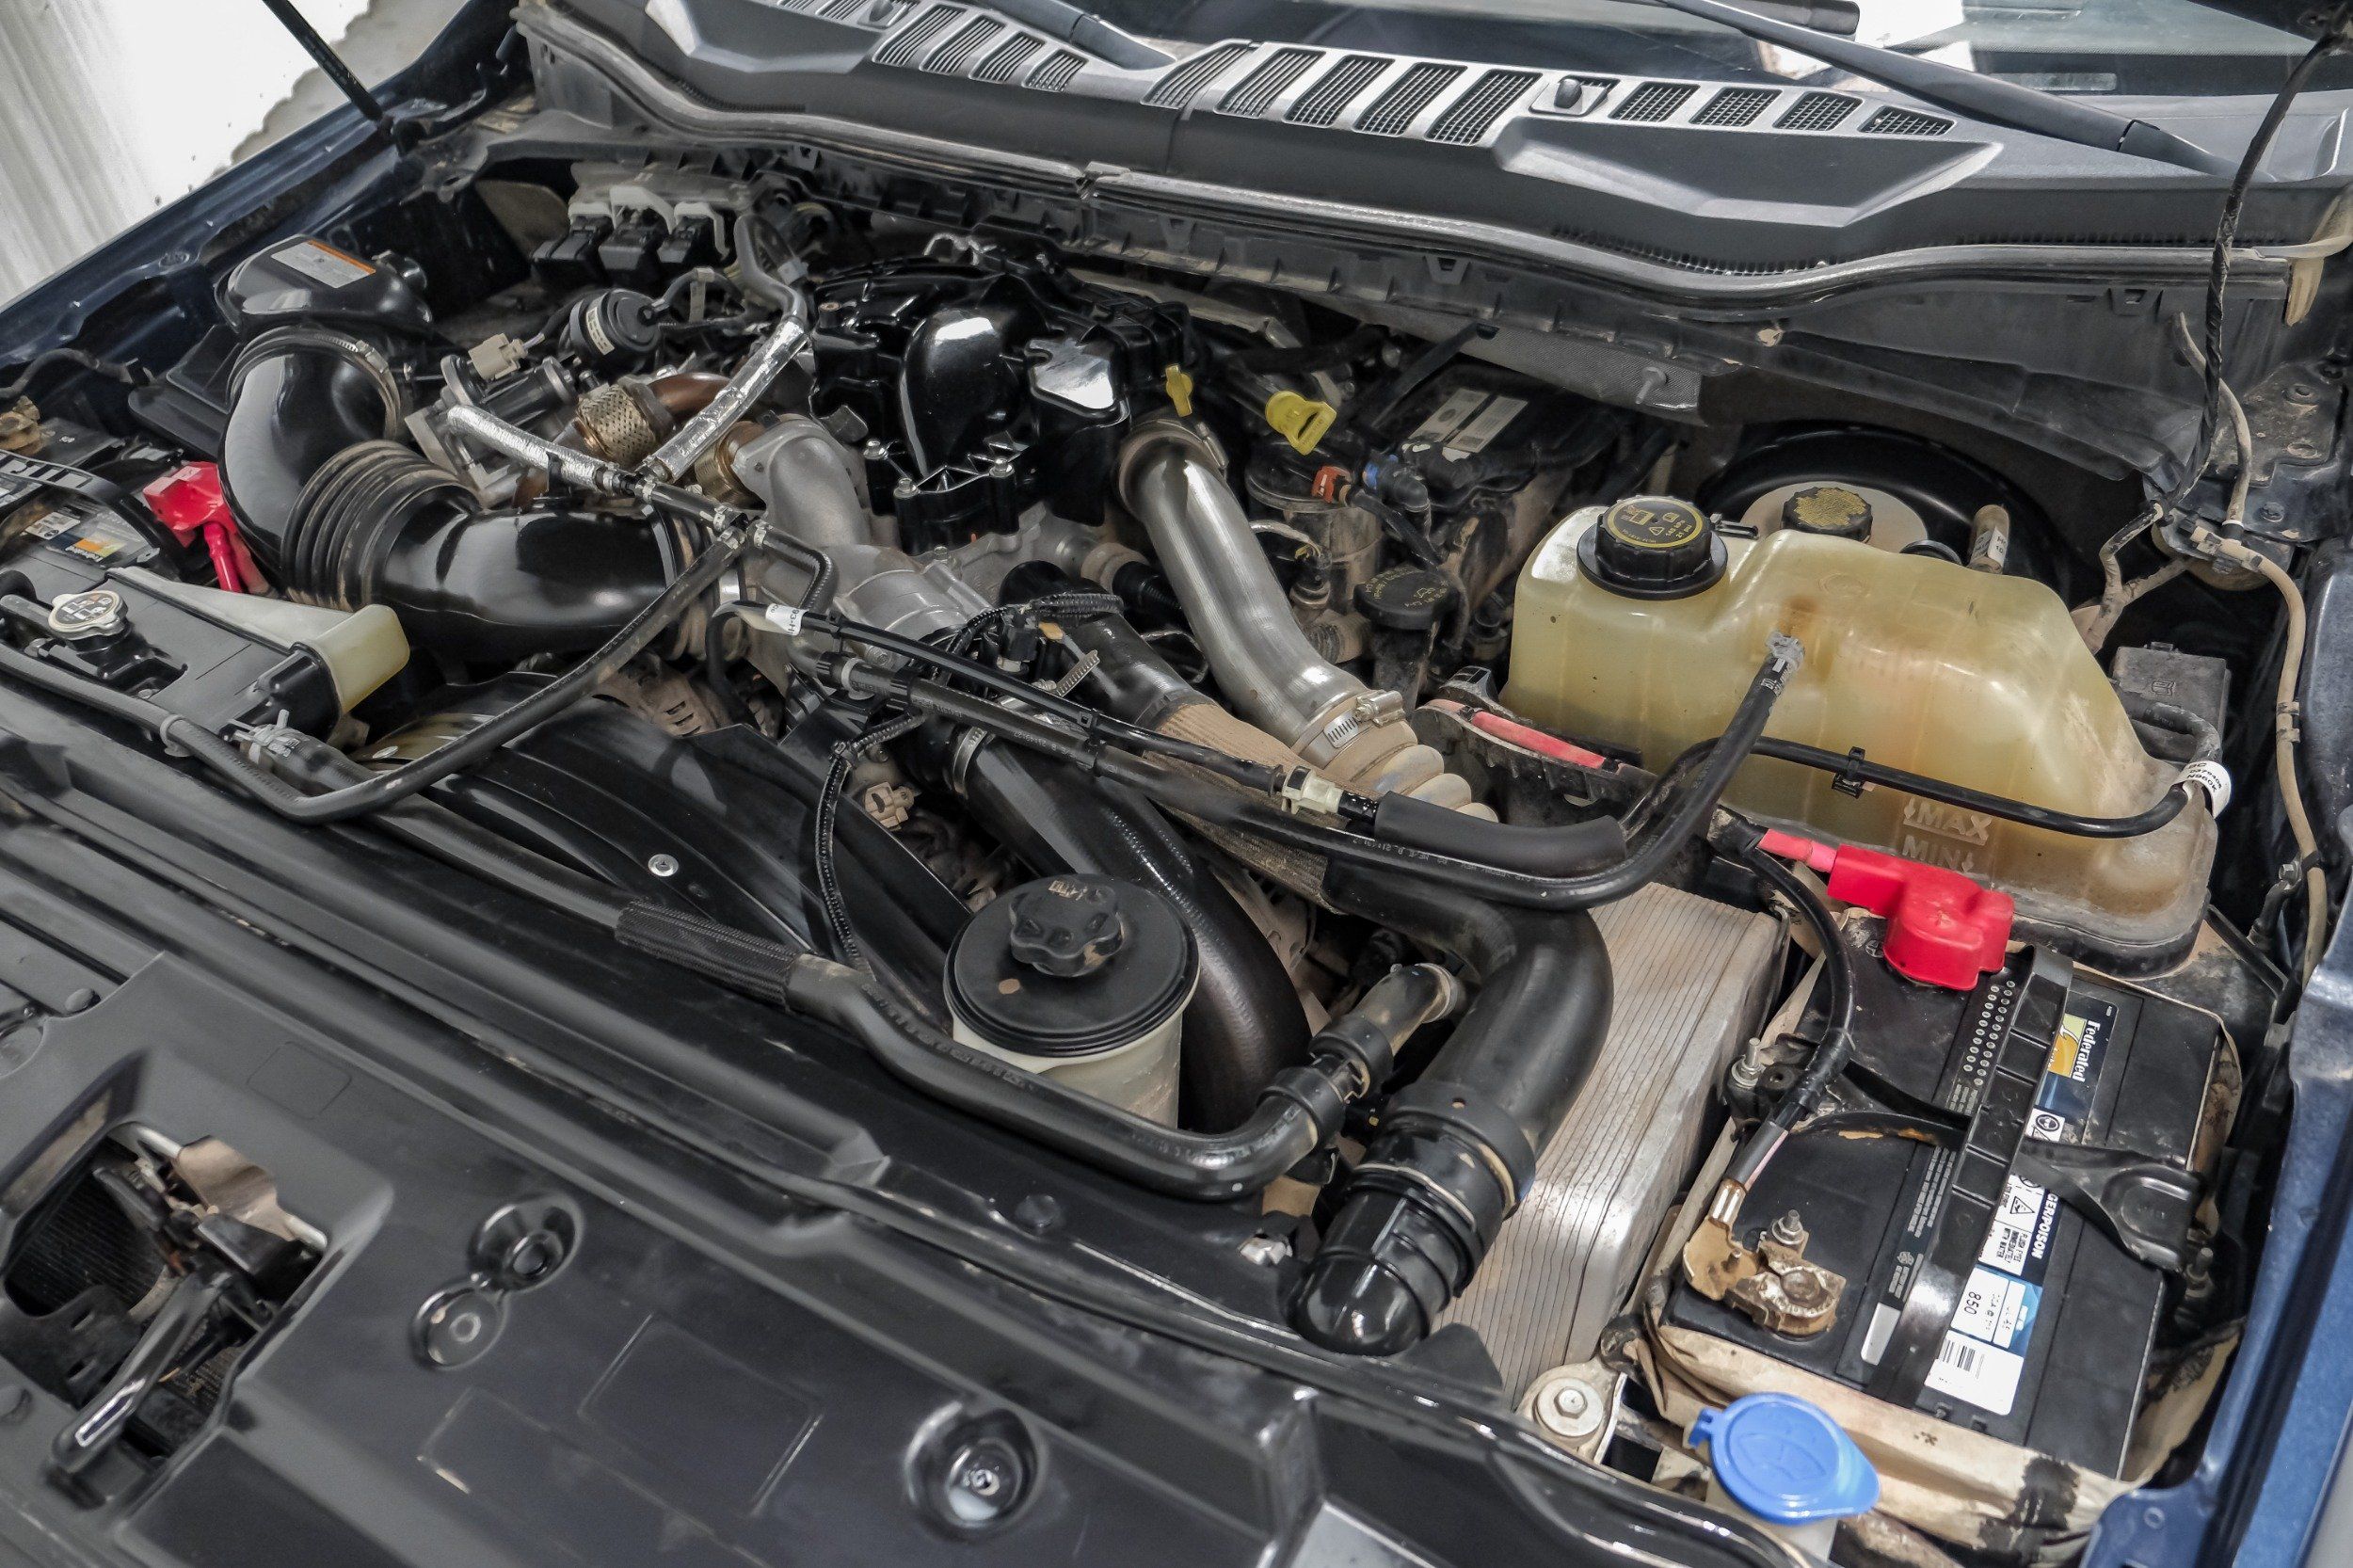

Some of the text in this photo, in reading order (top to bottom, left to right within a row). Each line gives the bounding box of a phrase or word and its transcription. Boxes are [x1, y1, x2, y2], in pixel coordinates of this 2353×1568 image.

[1916, 800, 1992, 841] MAX
[1901, 834, 1961, 871] MIN
[2072, 1020, 2101, 1082] Federated
[1963, 1291, 1982, 1316] 850
